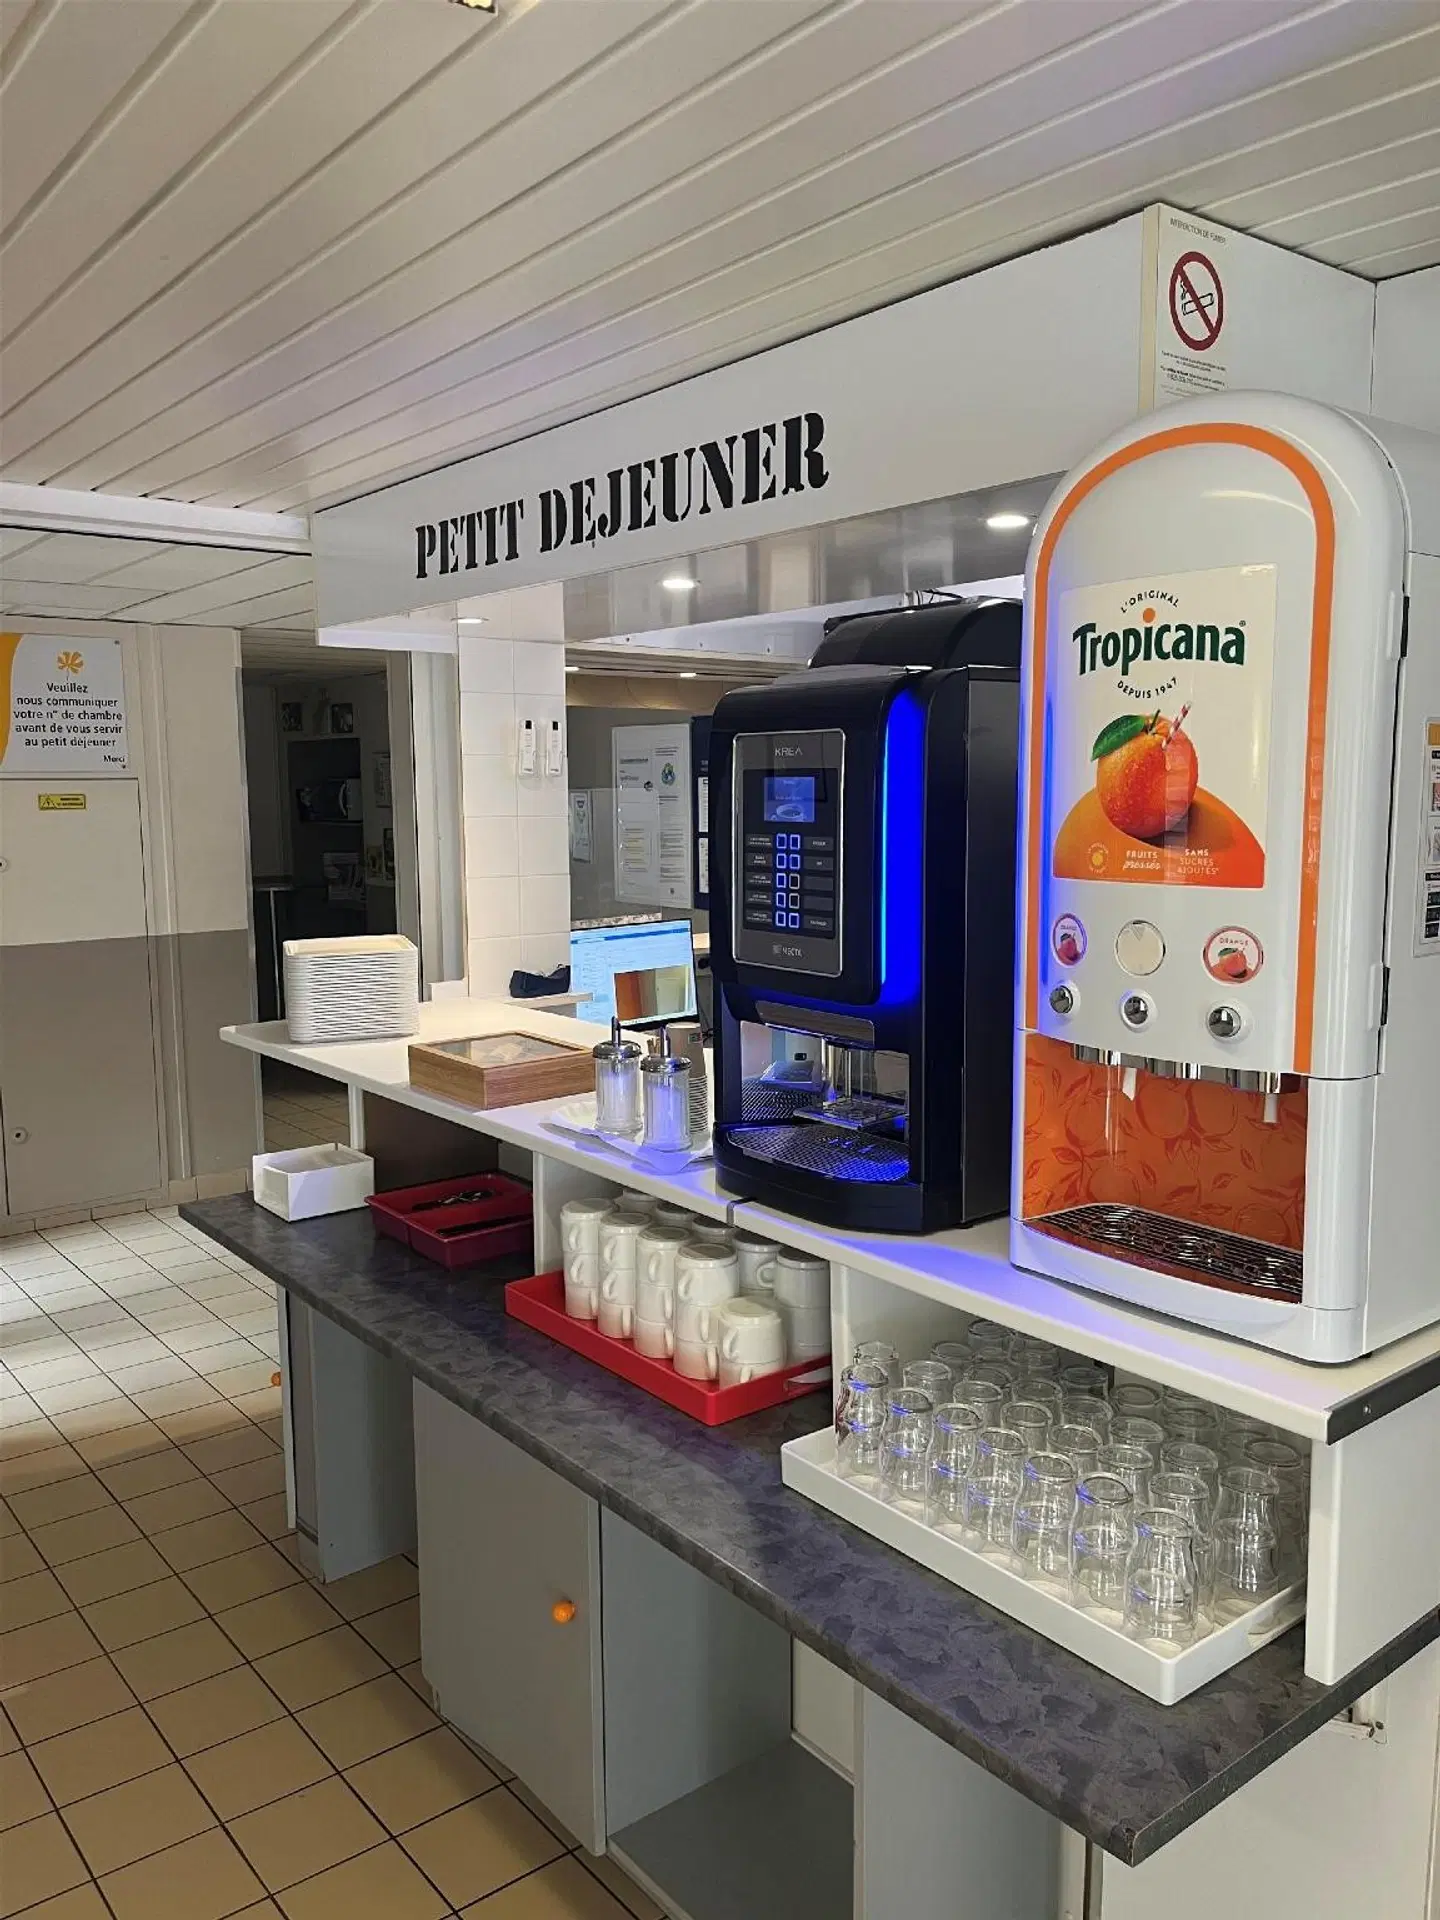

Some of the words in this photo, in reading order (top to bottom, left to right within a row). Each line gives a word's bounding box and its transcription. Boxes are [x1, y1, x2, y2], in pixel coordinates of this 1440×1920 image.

[415, 499, 523, 578] PETIT
[539, 412, 829, 553] DEJEUNER
[1120, 590, 1179, 613] L'ORIGINAL
[1072, 607, 1246, 676] Tropicana
[47, 682, 88, 693] Veuillez
[1117, 680, 1151, 698] DEPUIS
[1155, 677, 1177, 696] 1947
[17, 697, 43, 705] nous
[46, 697, 118, 708] communiquer
[13, 710, 43, 719] votre
[61, 710, 75, 720] de
[78, 710, 122, 720] chambre
[15, 723, 46, 733] avant
[50, 723, 63, 733] de
[66, 725, 91, 734] vous
[93, 724, 122, 734] servir
[25, 738, 38, 747] au
[41, 737, 67, 748] petit
[103, 755, 126, 763] Merci
[1126, 850, 1158, 859] FRUITS
[1185, 848, 1209, 857] SANS
